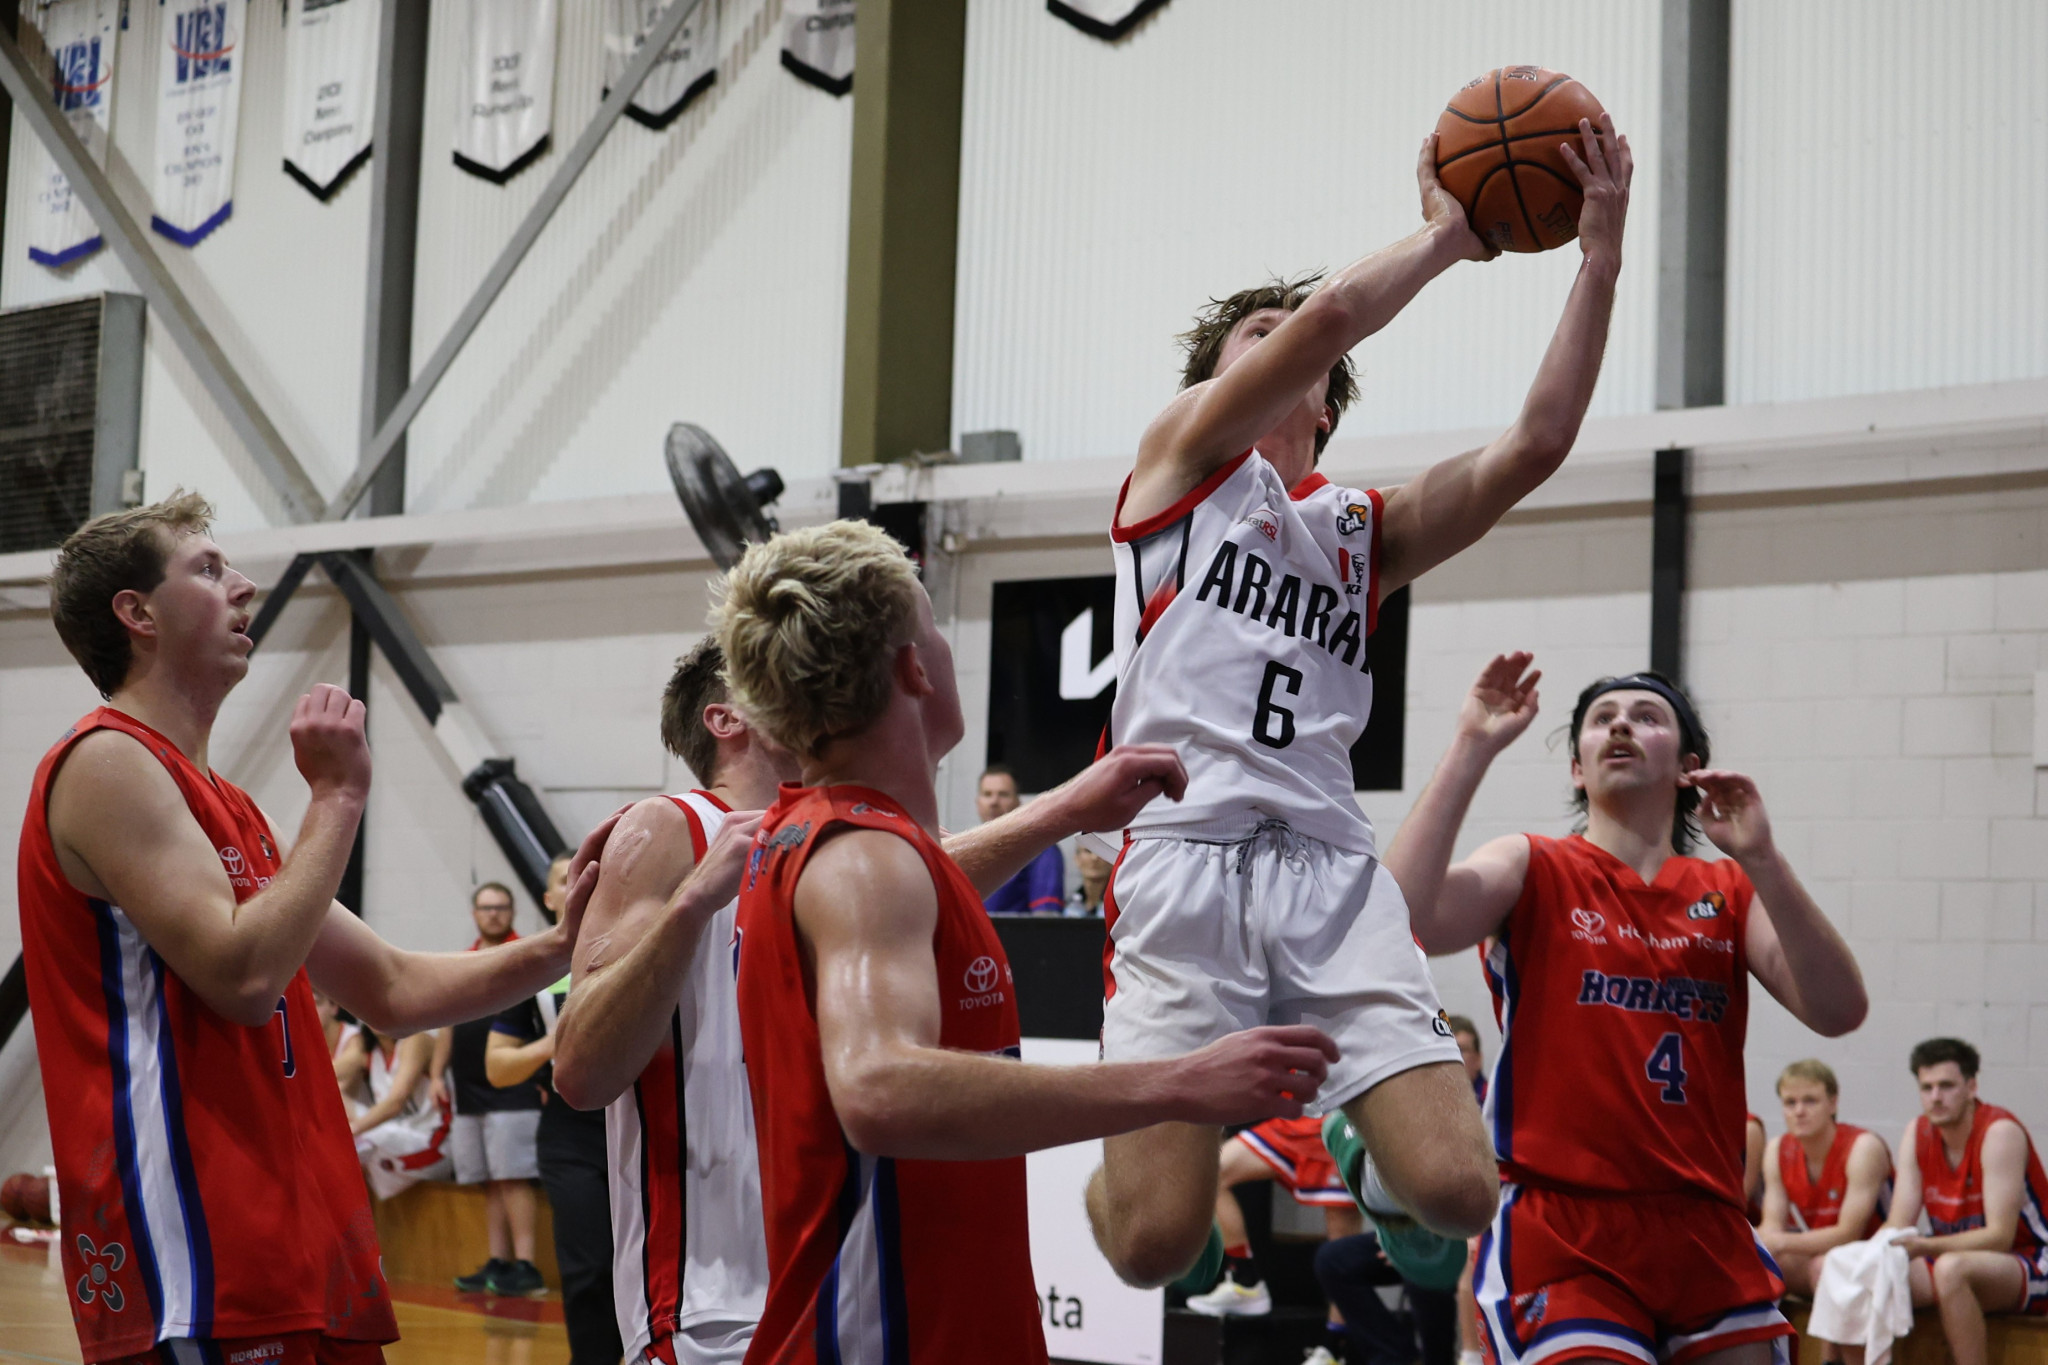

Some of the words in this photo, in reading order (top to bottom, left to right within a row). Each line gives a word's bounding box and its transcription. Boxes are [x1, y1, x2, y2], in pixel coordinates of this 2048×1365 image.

[1247, 516, 1278, 541] ratRSL
[1344, 583, 1362, 595] KF
[1196, 540, 1370, 675] ARARA
[1252, 660, 1304, 750] 6
[230, 877, 252, 887] YOTA
[959, 991, 1005, 1010] TOYOTA
[1576, 969, 1729, 1024] HORNETS
[1645, 1032, 1687, 1105] 4
[1038, 1285, 1083, 1329] ta
[230, 1341, 284, 1364] HORNETS
